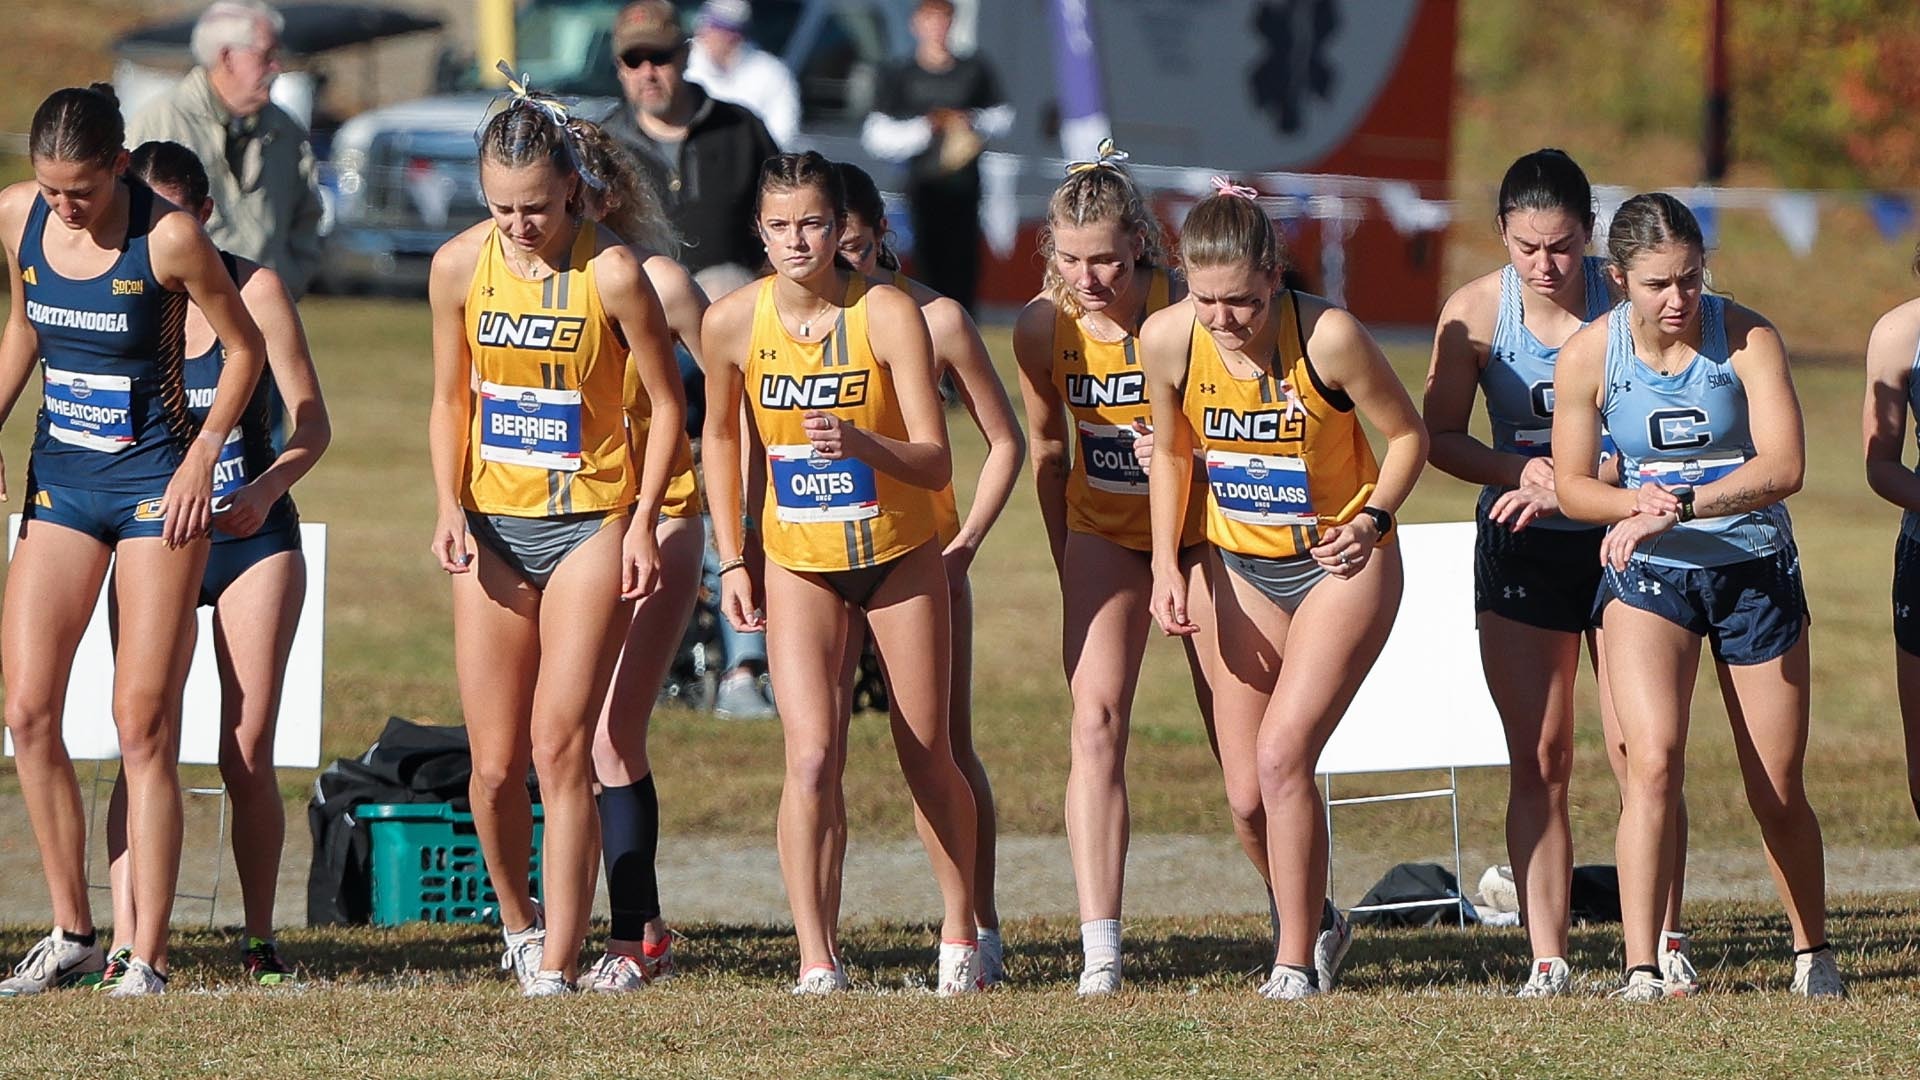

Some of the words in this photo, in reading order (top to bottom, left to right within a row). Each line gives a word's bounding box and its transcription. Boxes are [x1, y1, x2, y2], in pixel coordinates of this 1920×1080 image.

[26, 300, 129, 333] CHATTANOOGA
[477, 310, 587, 353] UNCG
[760, 369, 870, 410] UNCG
[1066, 370, 1150, 408] UNC
[45, 393, 128, 425] WHEATCROFT
[491, 412, 568, 442] BERRIER
[1203, 406, 1307, 442] UNCG
[1645, 406, 1713, 453] C
[791, 471, 855, 496] OATES
